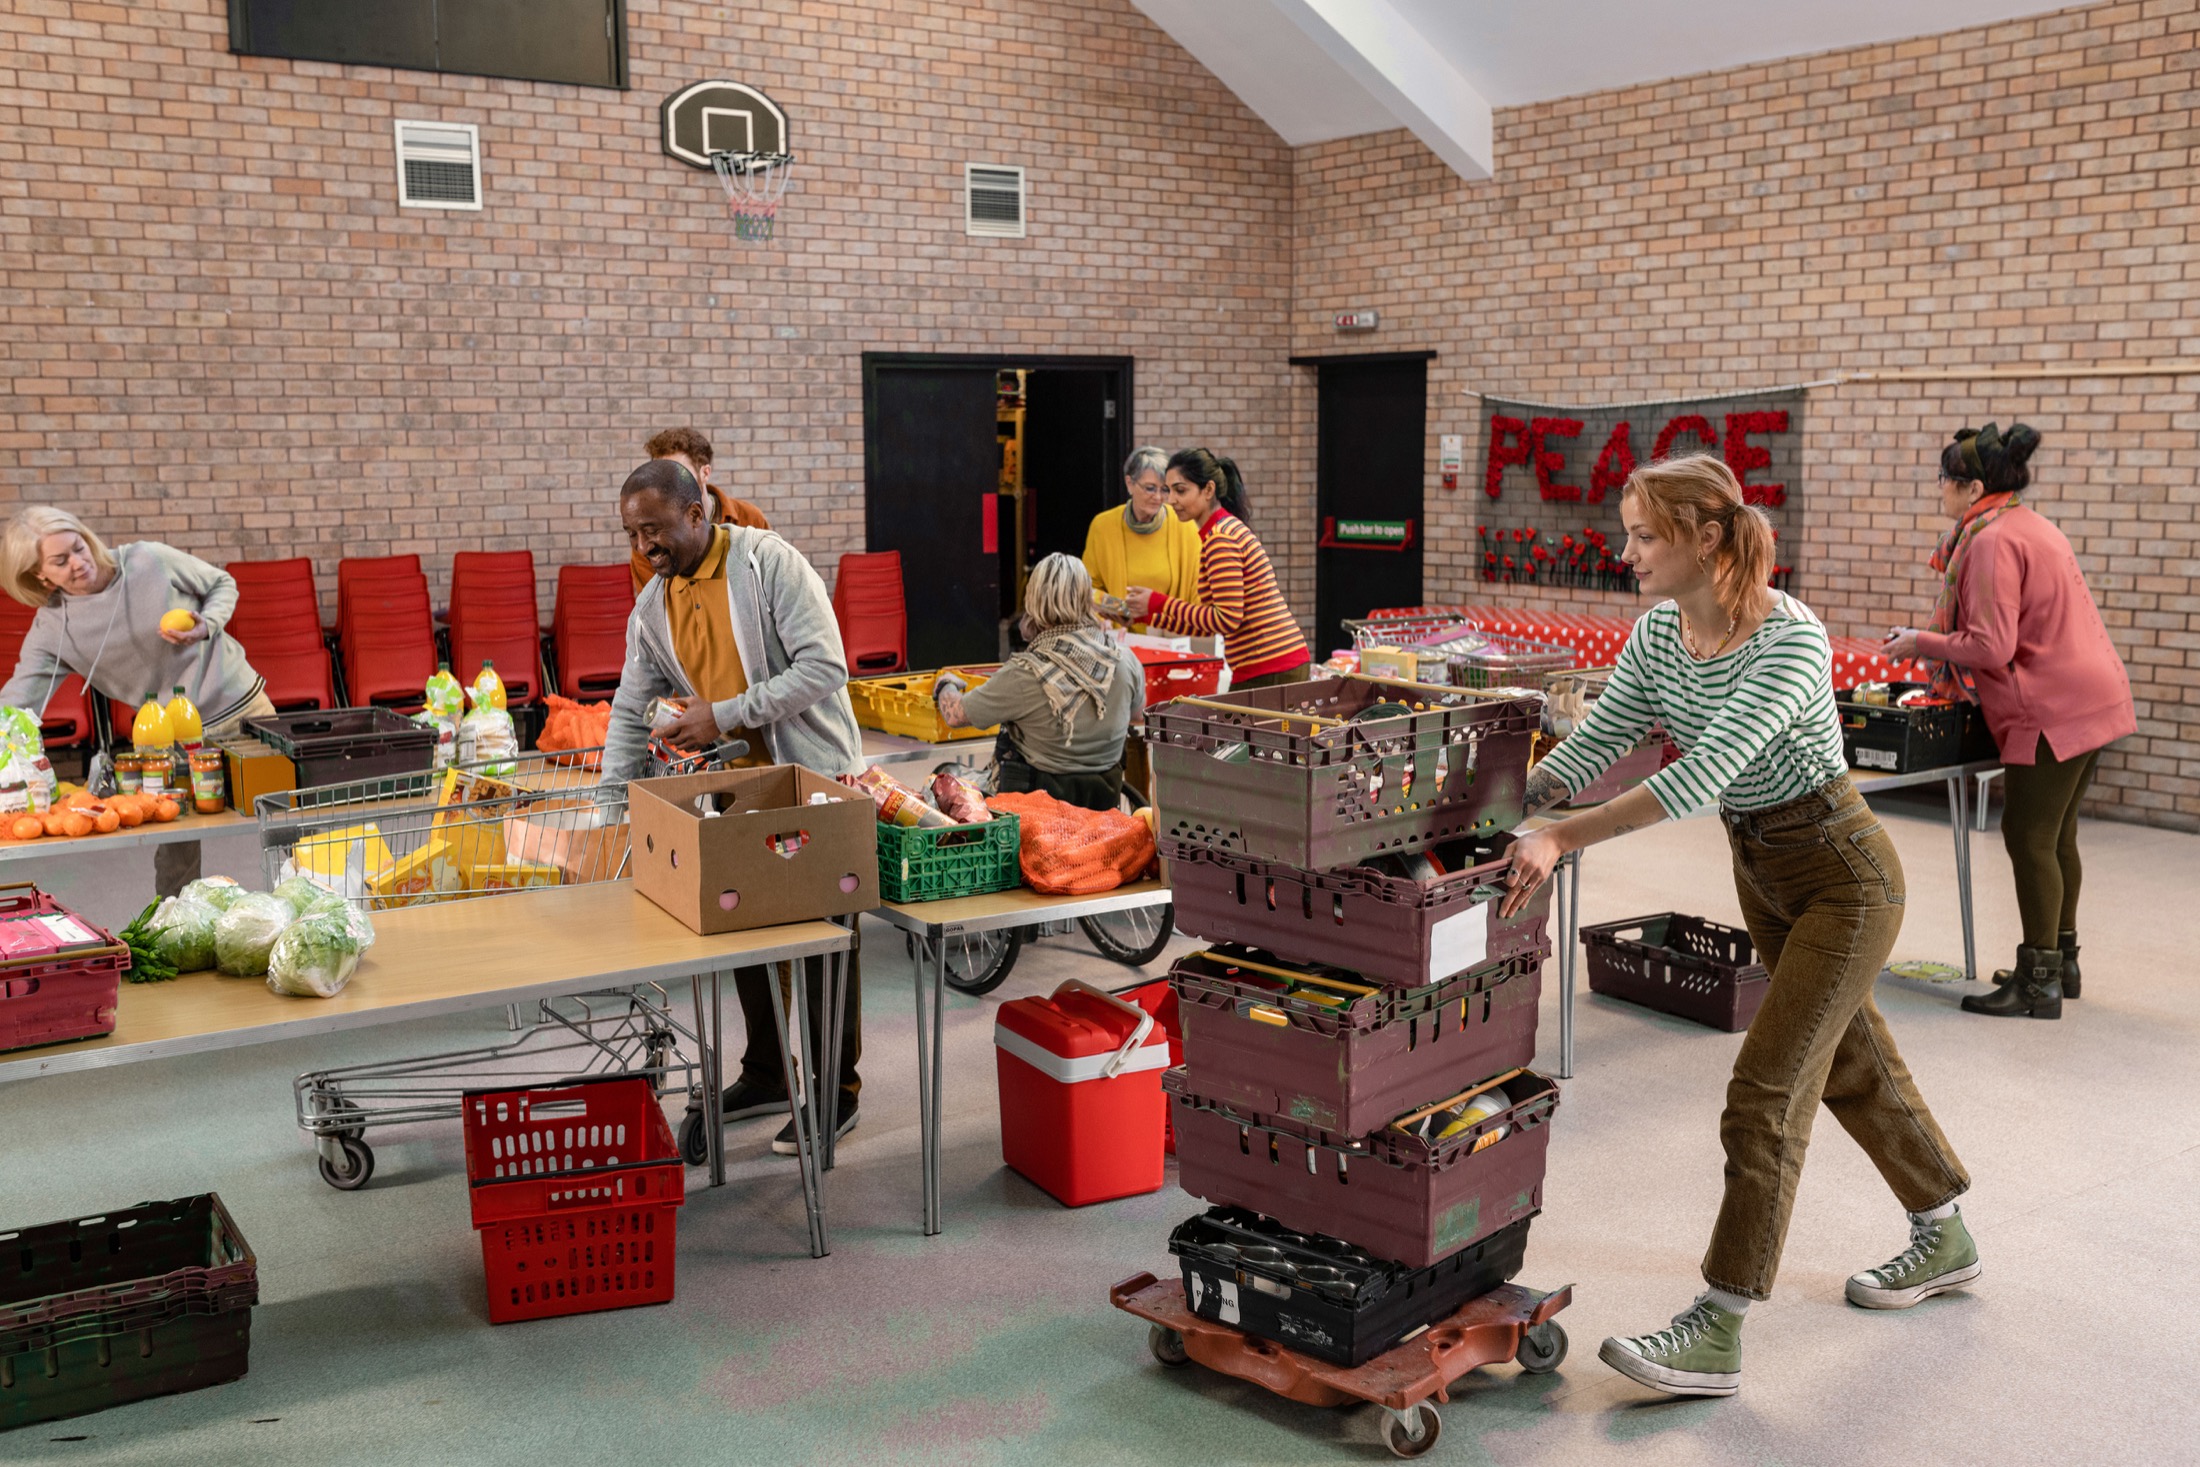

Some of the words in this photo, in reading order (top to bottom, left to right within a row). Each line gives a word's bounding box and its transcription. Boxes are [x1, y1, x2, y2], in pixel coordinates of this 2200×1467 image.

[1486, 410, 1789, 506] PEACE
[1340, 523, 1359, 535] Push
[1360, 523, 1373, 535] bar
[1375, 524, 1383, 536] to
[1384, 526, 1405, 538] open
